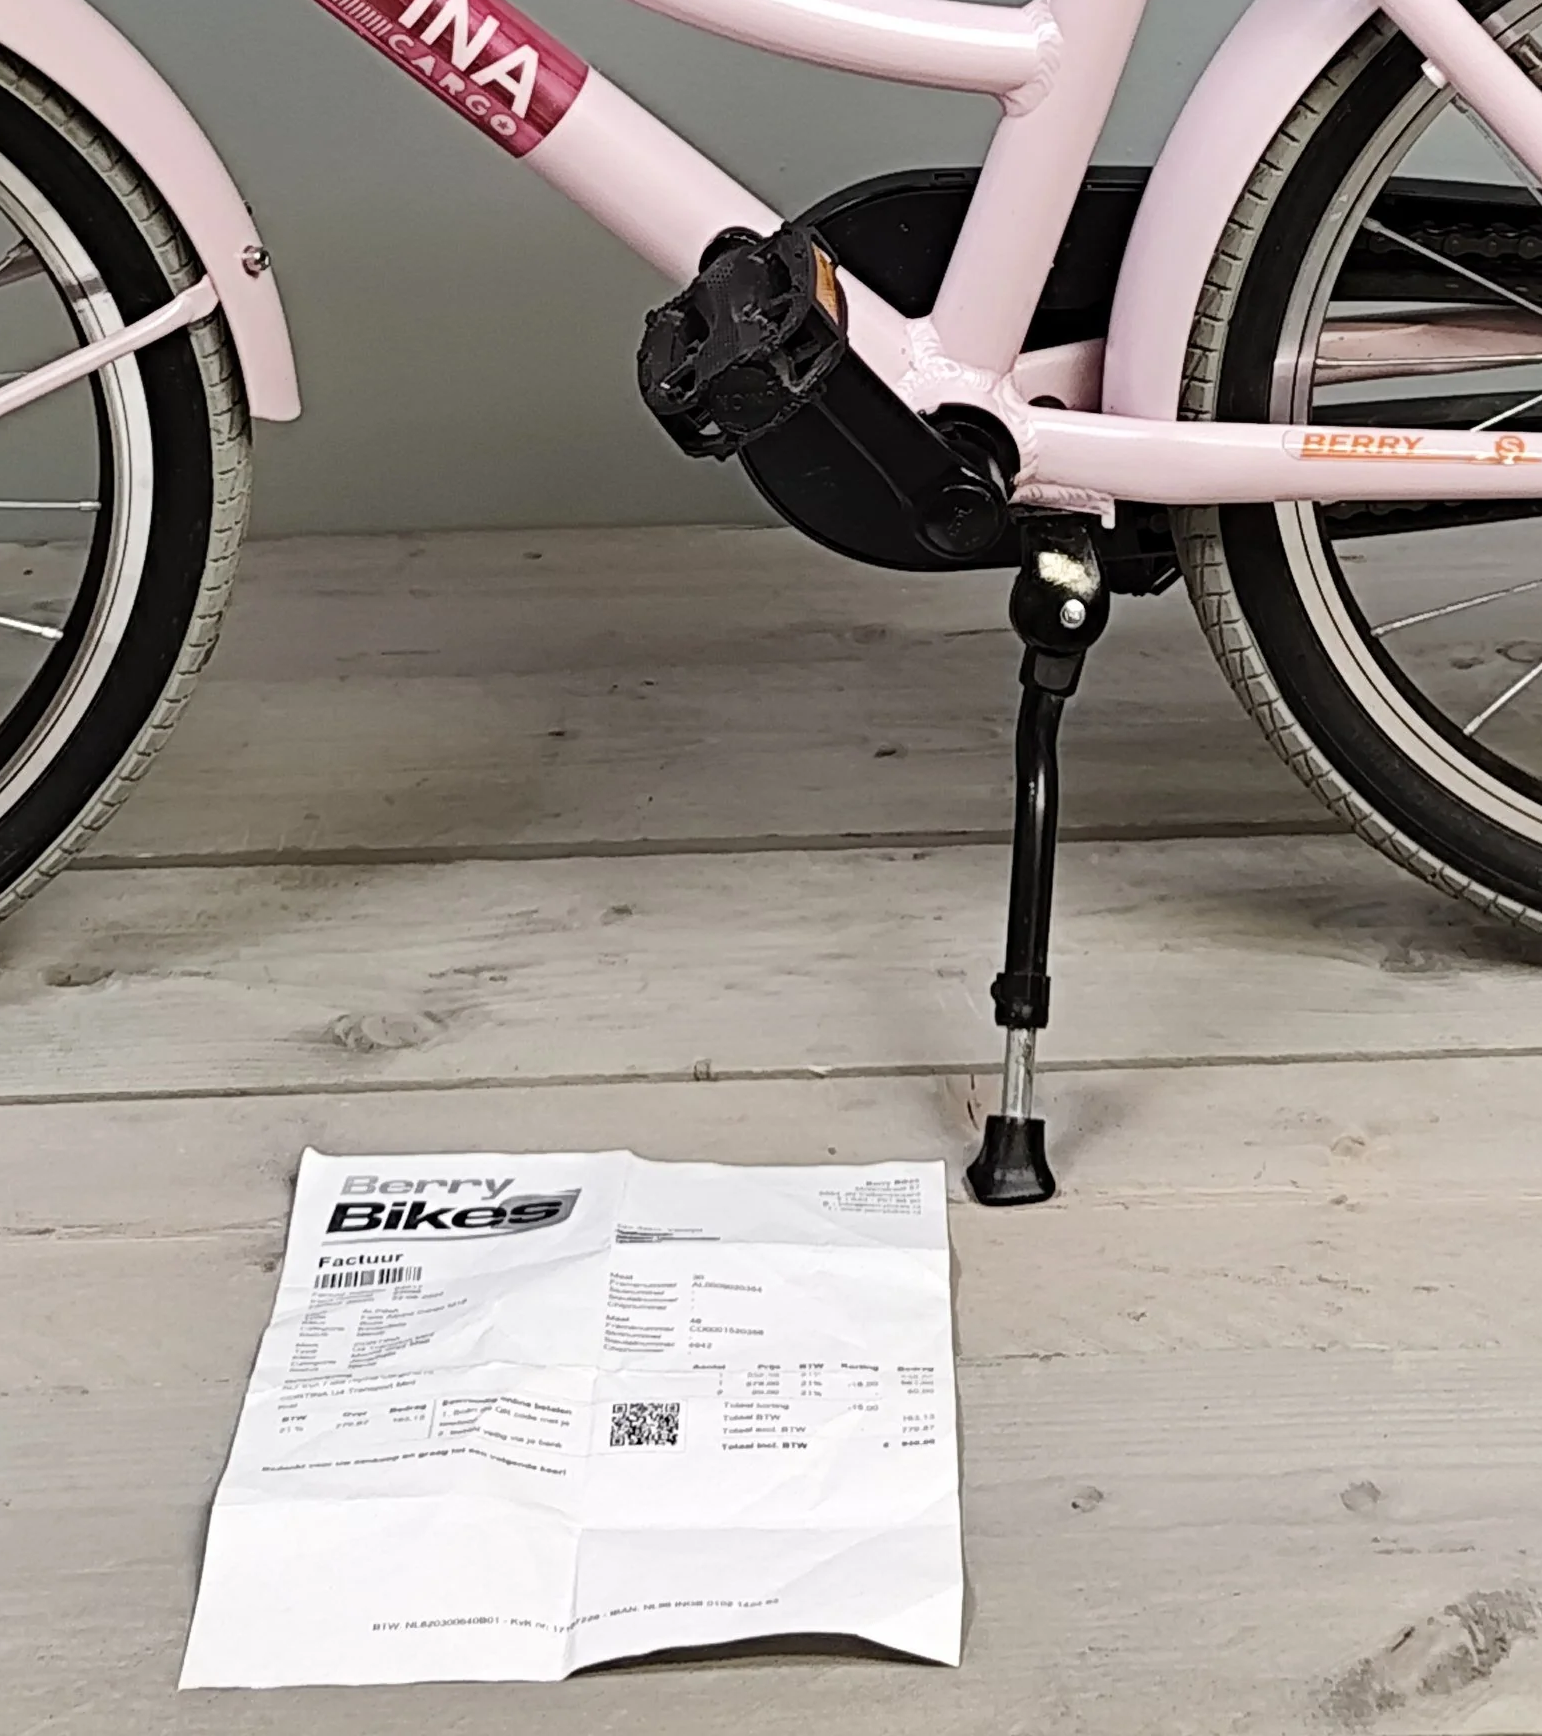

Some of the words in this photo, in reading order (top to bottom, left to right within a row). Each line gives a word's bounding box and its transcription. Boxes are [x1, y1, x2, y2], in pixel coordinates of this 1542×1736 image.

[389, 33, 517, 136] CARGO
[1302, 433, 1424, 454] BERRY
[340, 1175, 516, 1201] Berry
[326, 1200, 563, 1234] Bikes
[319, 1253, 404, 1269] Factuur
[534, 1402, 572, 1415] betalen
[510, 1618, 532, 1626] KvK
